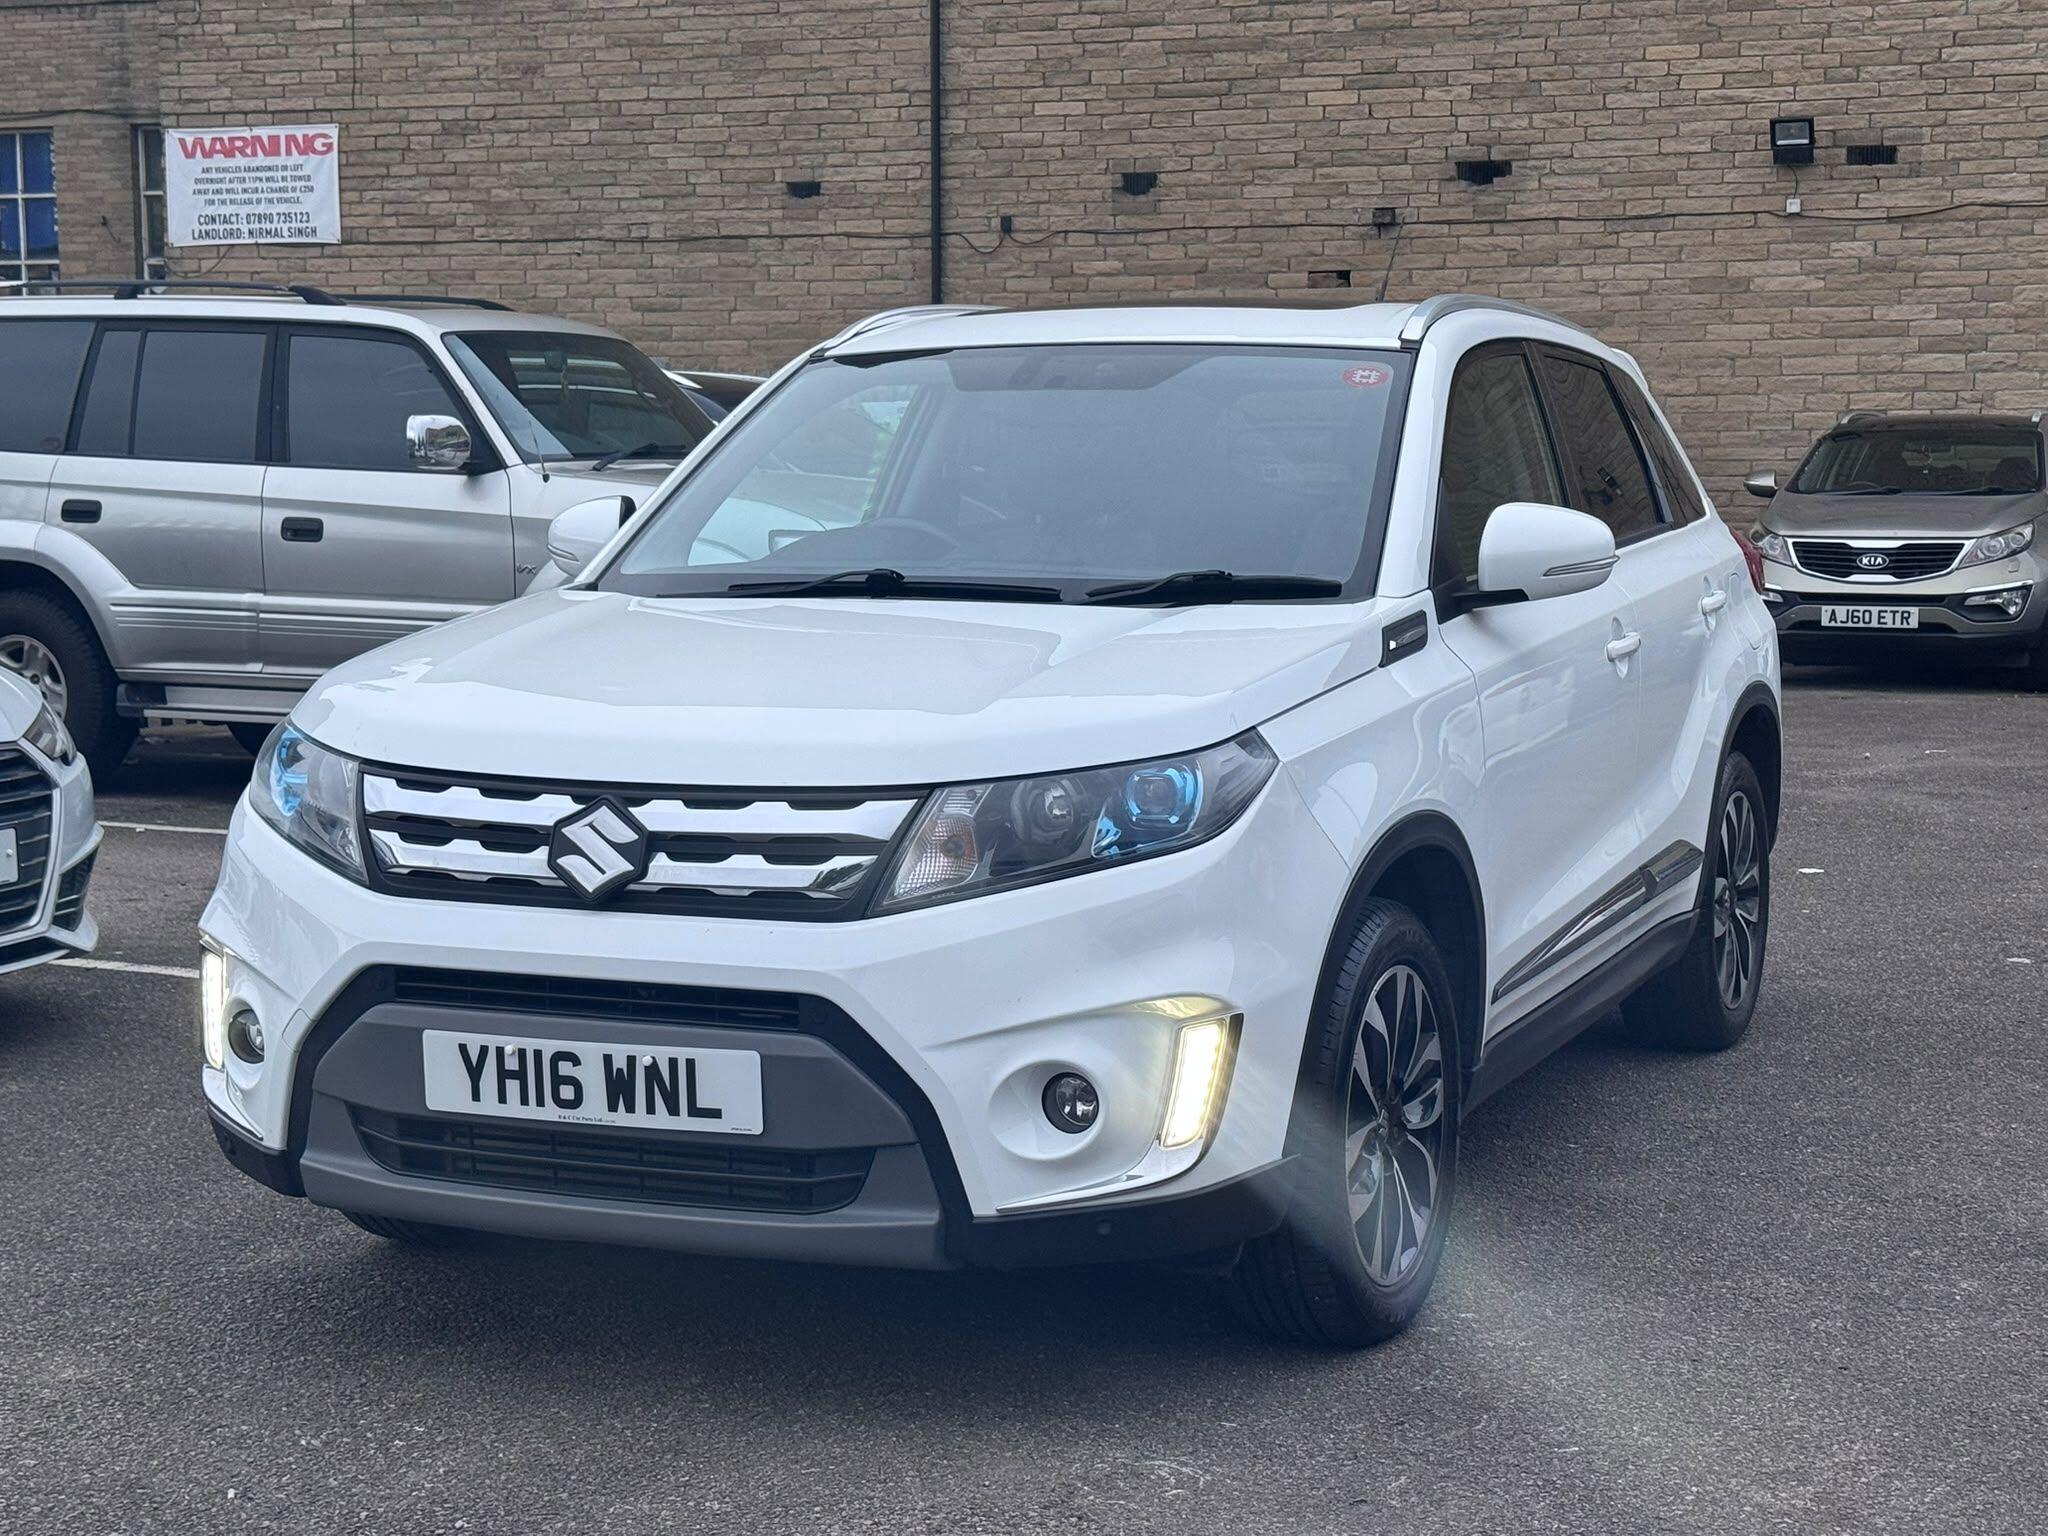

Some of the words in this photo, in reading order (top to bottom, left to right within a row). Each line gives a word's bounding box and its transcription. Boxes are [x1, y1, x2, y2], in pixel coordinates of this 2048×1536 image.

[177, 132, 334, 160] WARNING
[201, 166, 213, 174] ANY
[214, 165, 241, 174] VEHICLES
[243, 164, 279, 173] ABANDONED
[280, 164, 289, 172] OR
[290, 163, 304, 172] LEFT
[194, 177, 227, 185] OVERNIGHT
[228, 176, 247, 184] AFTER
[248, 175, 264, 183] 11PM
[265, 175, 280, 183] WILL
[281, 174, 288, 182] BE
[290, 174, 312, 182] TOWED
[192, 188, 210, 196] AWAY
[225, 187, 240, 195] WILL
[241, 186, 259, 194] INCUR
[266, 186, 289, 194] CHARGE
[290, 185, 298, 193] OF
[217, 198, 228, 206] THE
[229, 197, 255, 205] RELEASE
[256, 197, 263, 205] OF
[197, 213, 244, 226] CONTACT:
[245, 213, 274, 225] 07890
[276, 212, 311, 224] 735123
[192, 227, 246, 241] LANDLORD:
[248, 227, 286, 239] NIRMAL
[287, 226, 318, 238] SINGH
[1862, 556, 1883, 565] KIA
[1828, 608, 1873, 624] AJ60
[1877, 610, 1911, 625] ETR
[458, 1043, 584, 1110] YH16
[602, 1053, 722, 1119] WNL
